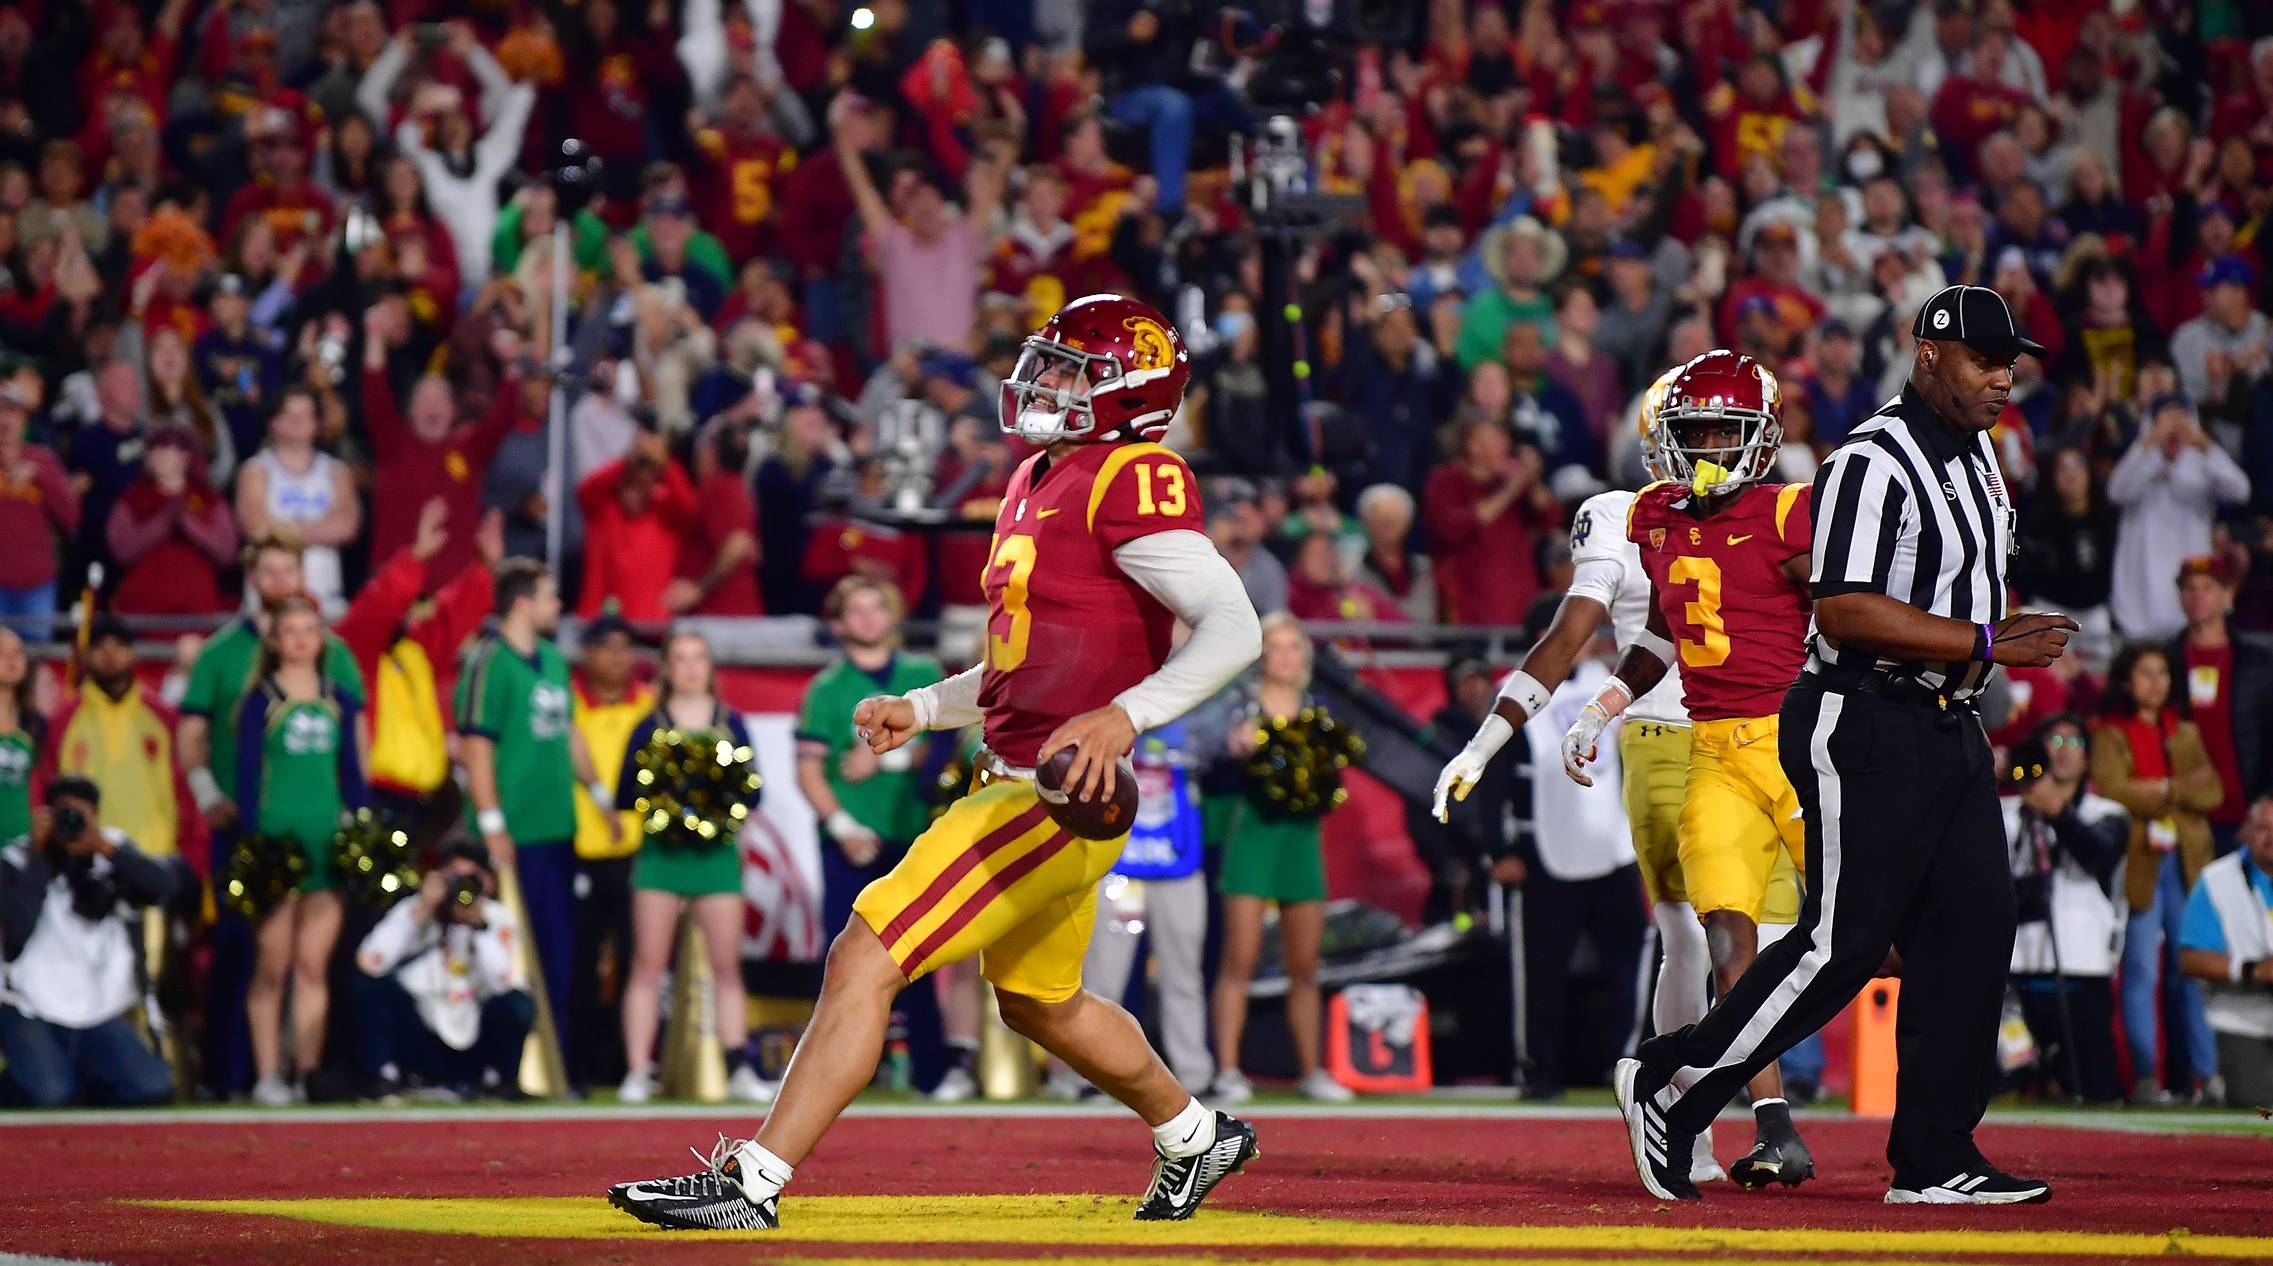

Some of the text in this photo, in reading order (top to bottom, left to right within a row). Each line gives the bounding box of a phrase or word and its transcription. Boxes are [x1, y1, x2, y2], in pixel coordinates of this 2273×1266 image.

[1937, 313, 1945, 325] Z
[1134, 463, 1187, 517] 13
[1942, 481, 1956, 501] S
[1669, 555, 1731, 667] 3
